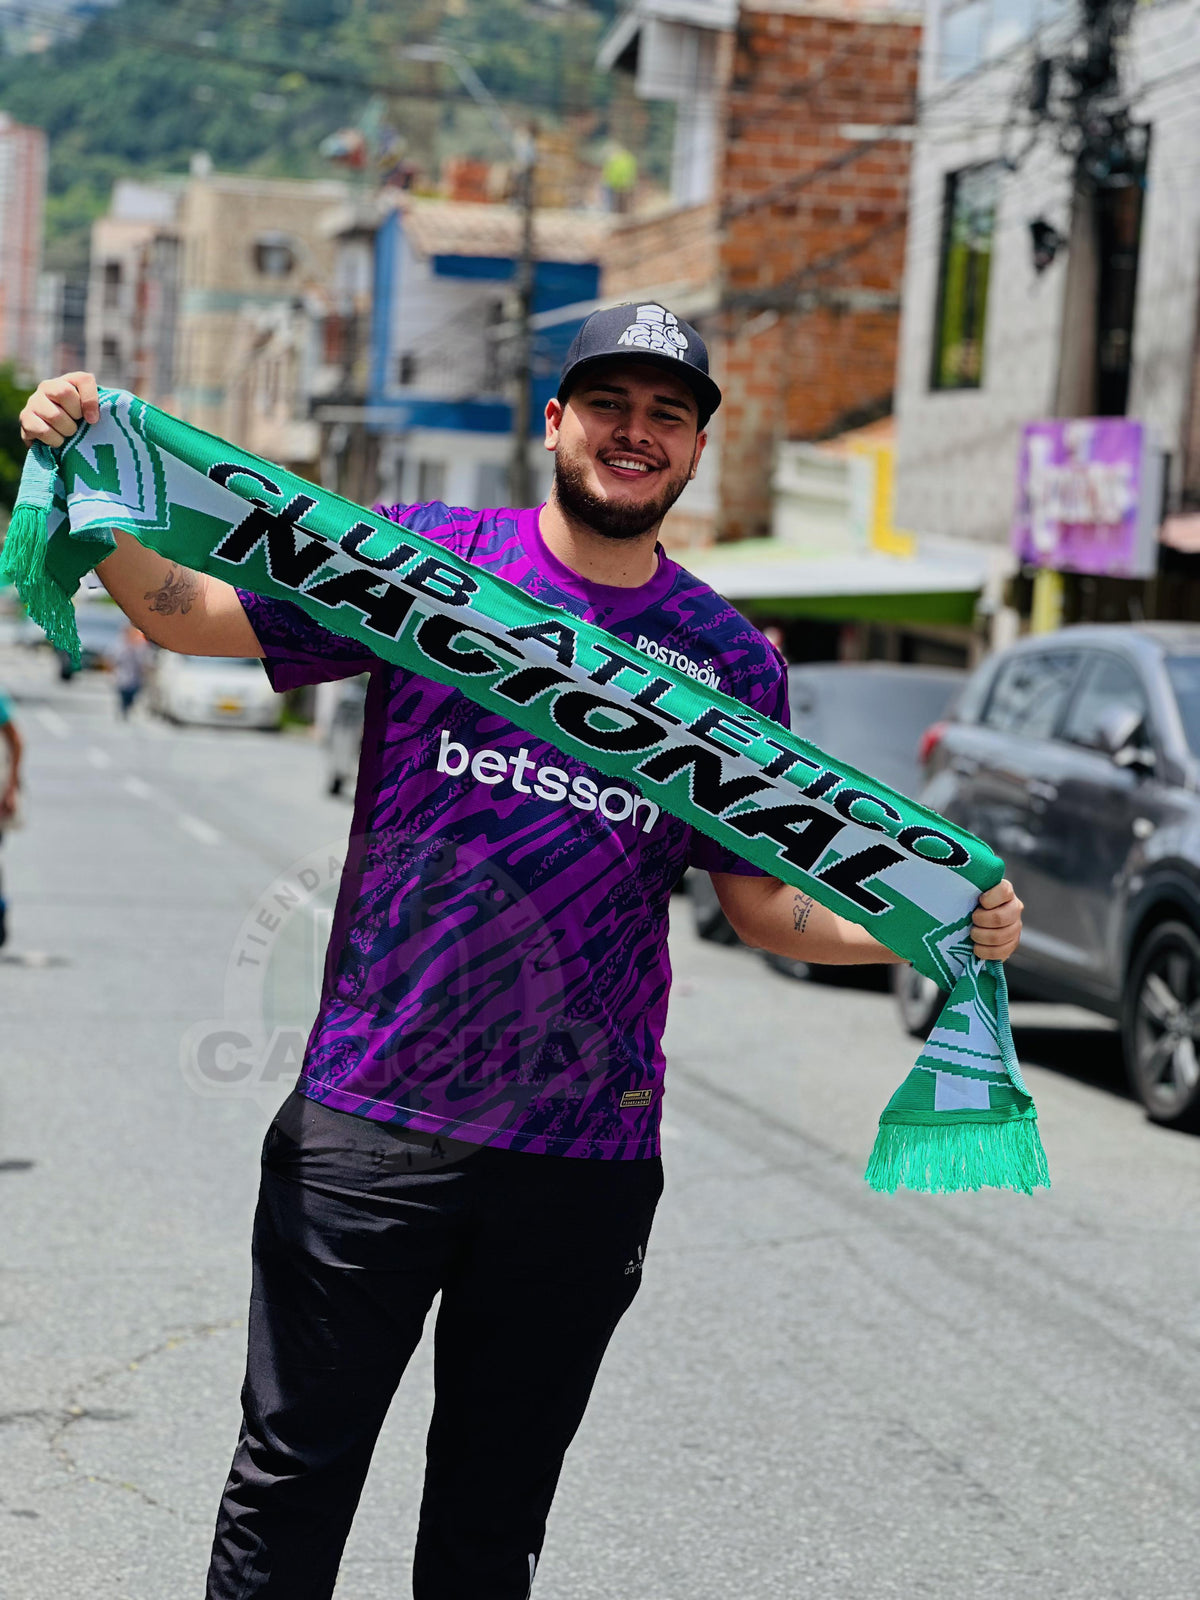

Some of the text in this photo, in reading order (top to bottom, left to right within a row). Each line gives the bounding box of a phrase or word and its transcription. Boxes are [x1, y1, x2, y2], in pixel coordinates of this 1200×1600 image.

[208, 462, 971, 868] CLUB ATLÉTICO
[210, 507, 908, 916] NACIONAL
[436, 729, 660, 834] betsson
